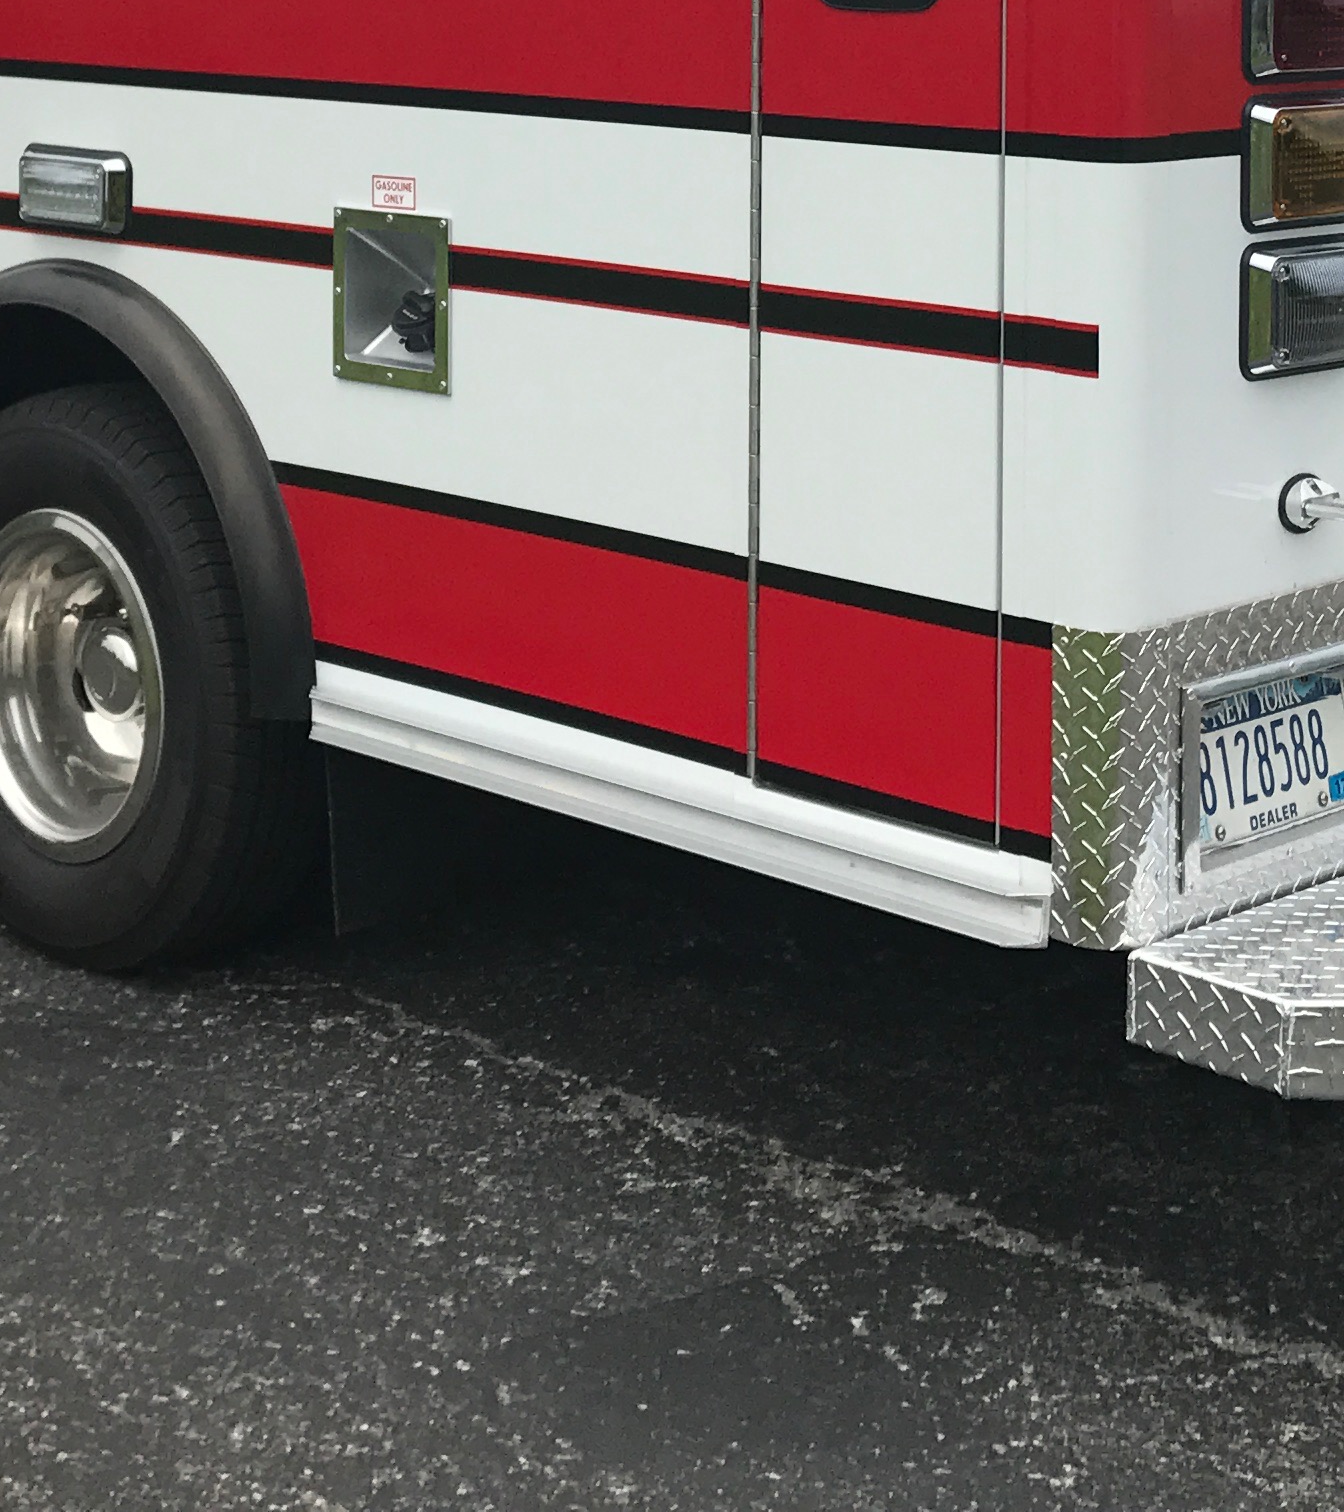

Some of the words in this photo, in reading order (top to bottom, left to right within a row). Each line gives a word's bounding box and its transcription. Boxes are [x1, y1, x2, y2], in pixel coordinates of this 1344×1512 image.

[375, 180, 412, 192] GASOLINE
[383, 193, 404, 204] ONLY
[1212, 691, 1251, 727] NEW
[1255, 678, 1302, 714] YORK
[1249, 801, 1298, 831] DEALER
